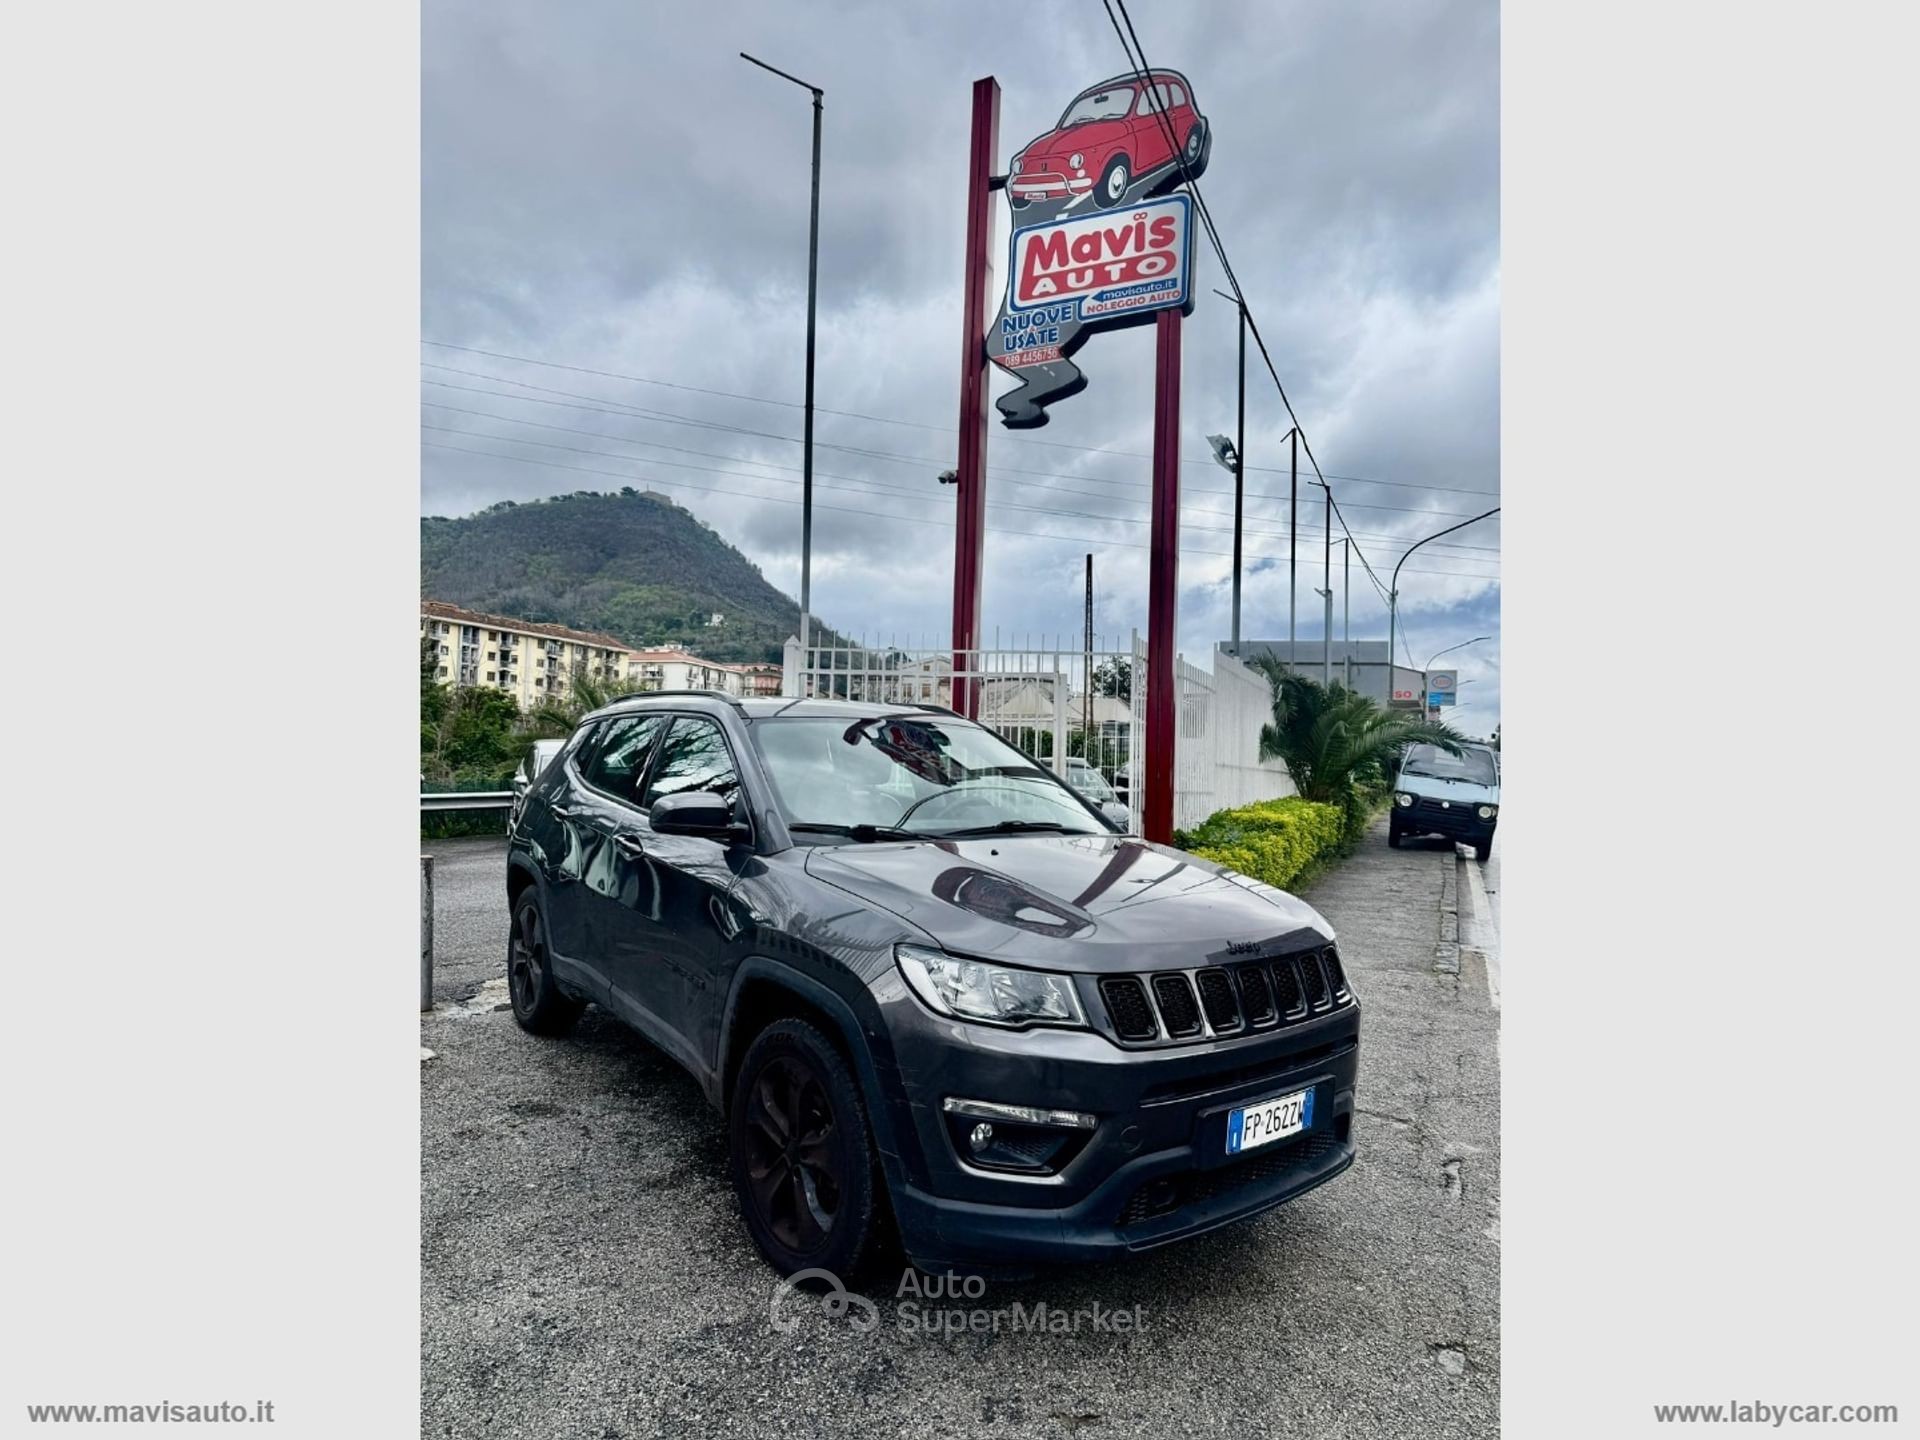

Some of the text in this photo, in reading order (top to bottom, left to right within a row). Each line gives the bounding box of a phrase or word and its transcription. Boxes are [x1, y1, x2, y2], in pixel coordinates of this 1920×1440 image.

[1032, 256, 1168, 296] AUTO
[1086, 289, 1181, 314] NOLEGGIO AUTO
[1102, 280, 1174, 300] mavisauto.it
[1002, 305, 1072, 333] NUOVE
[1005, 327, 1058, 351] USATE
[1005, 354, 1020, 367] 089
[1225, 940, 1261, 955] Jeep
